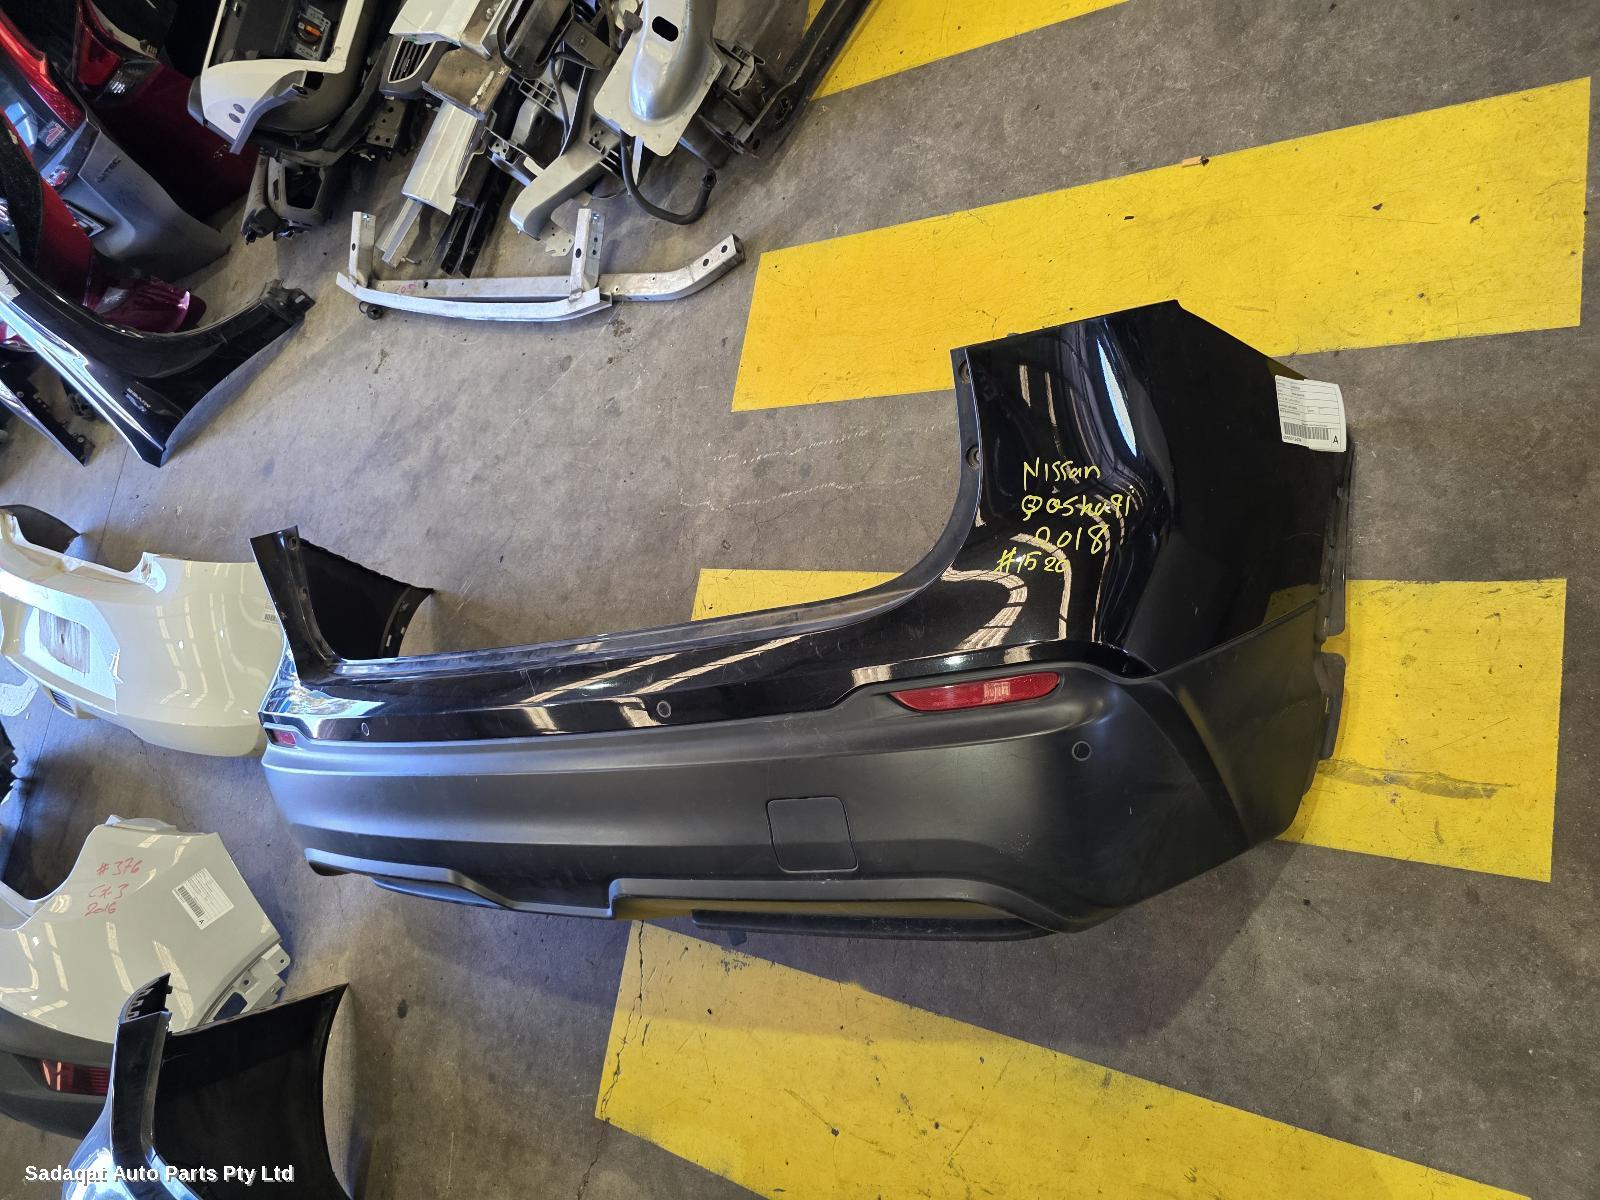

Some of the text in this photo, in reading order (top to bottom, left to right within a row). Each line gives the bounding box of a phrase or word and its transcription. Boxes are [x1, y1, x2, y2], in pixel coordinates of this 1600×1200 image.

[1332, 435, 1339, 444] A
[1023, 457, 1101, 491] Nissan
[84, 901, 118, 917] 2016
